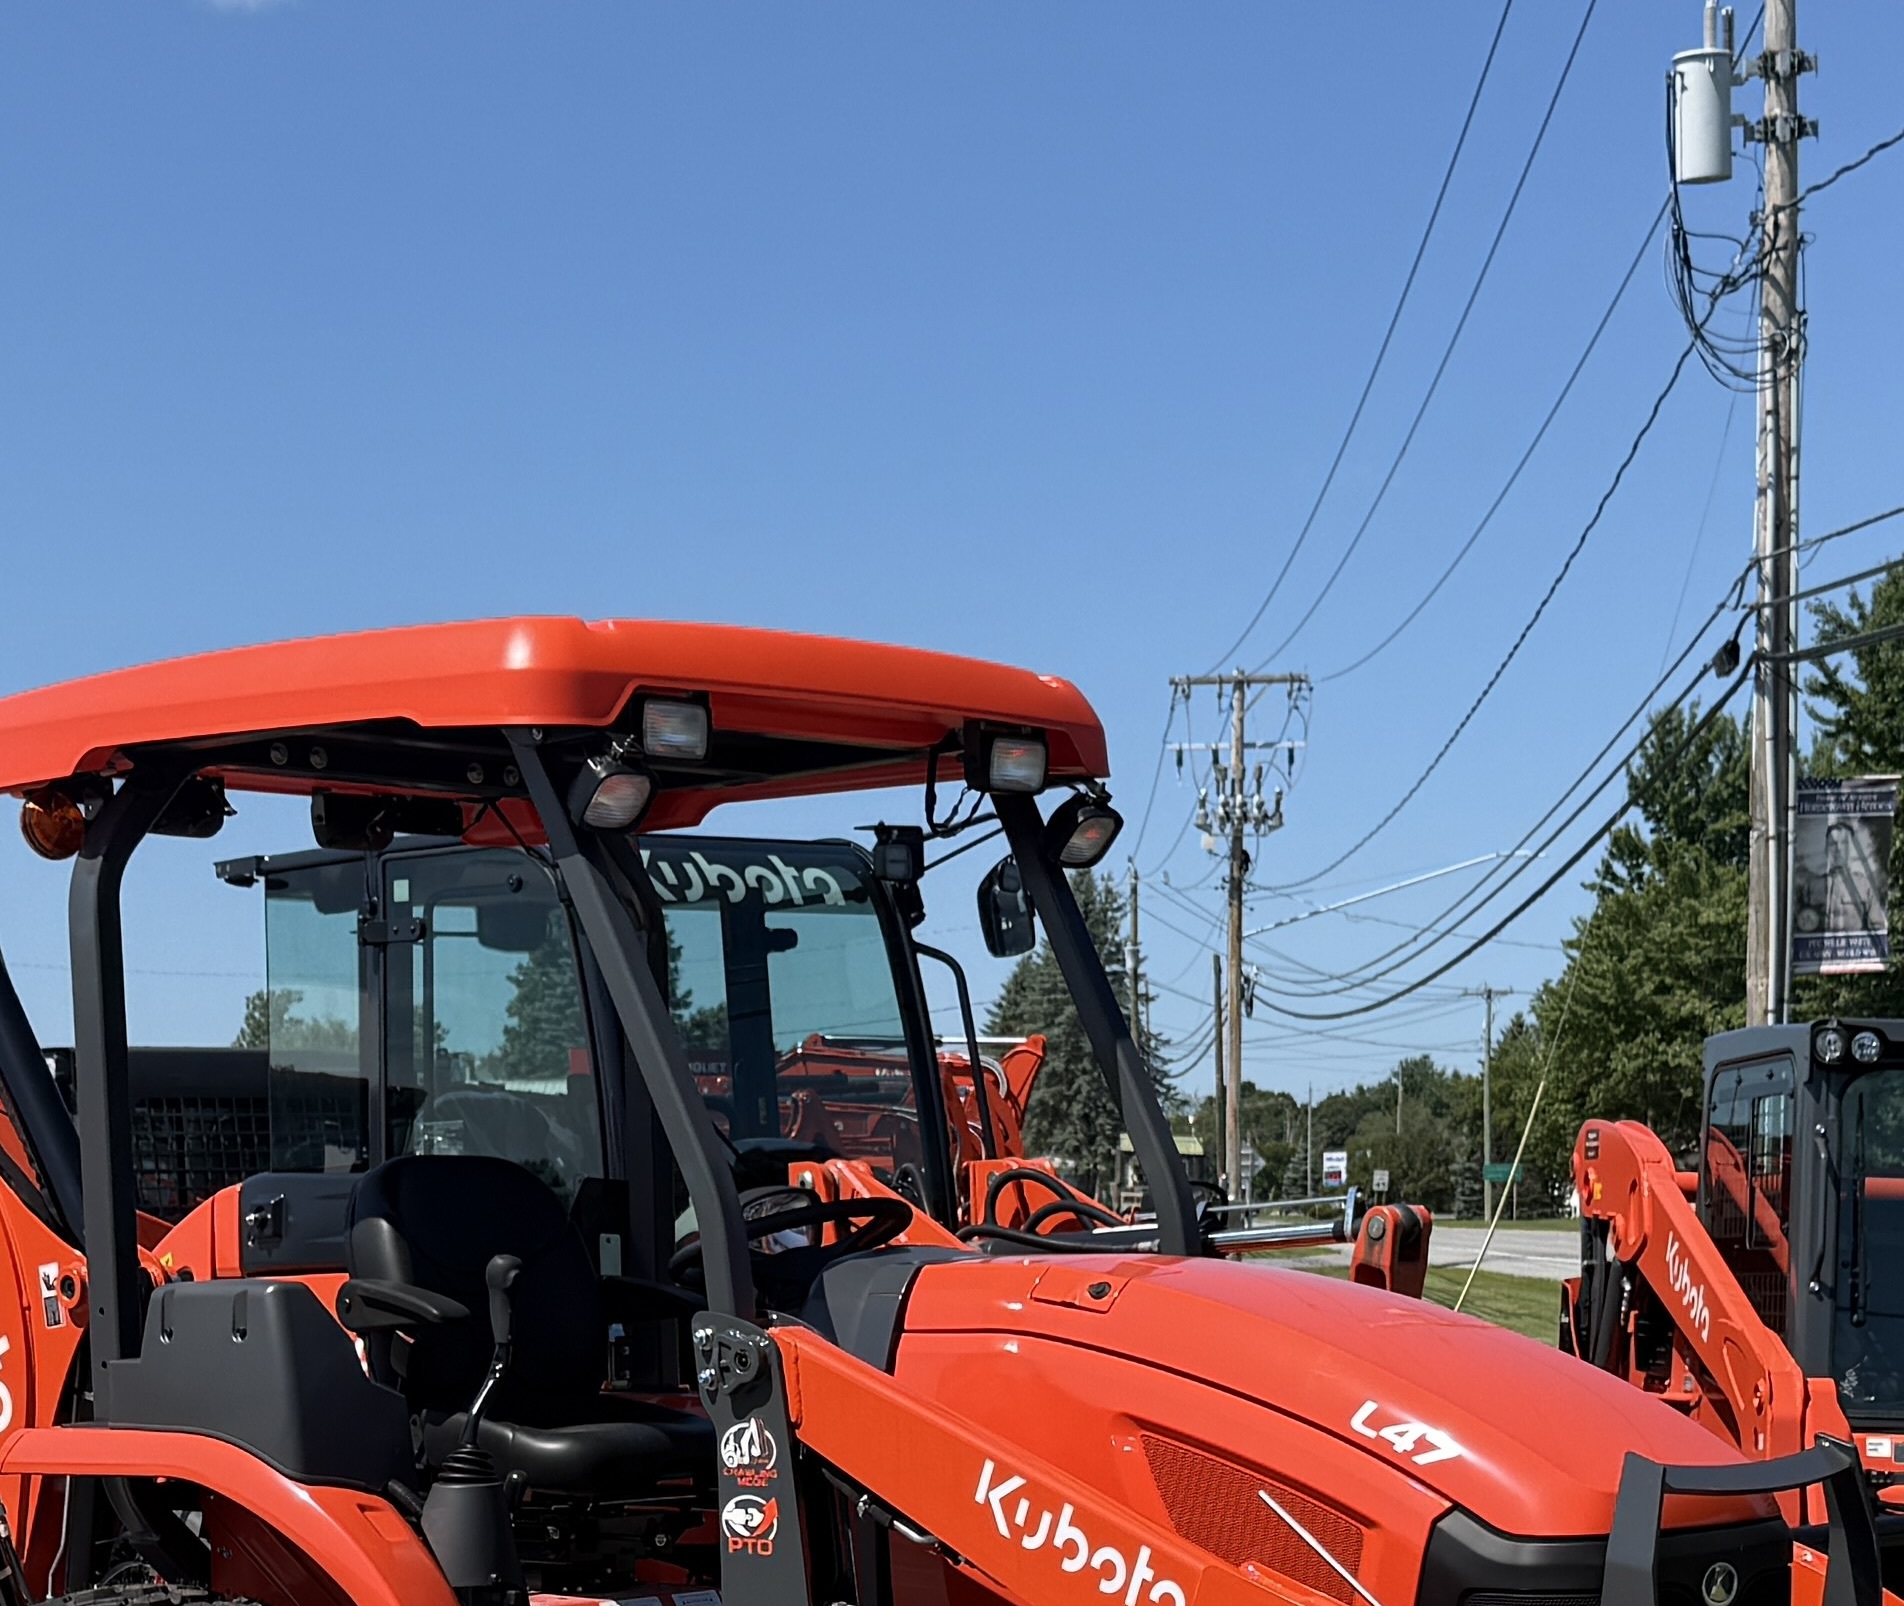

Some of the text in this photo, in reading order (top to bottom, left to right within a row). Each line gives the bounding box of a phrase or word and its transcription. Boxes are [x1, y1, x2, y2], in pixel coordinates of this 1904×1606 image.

[1666, 1231, 1710, 1343] Kubota
[1350, 1399, 1463, 1466] L47
[728, 1537, 773, 1556] PTO
